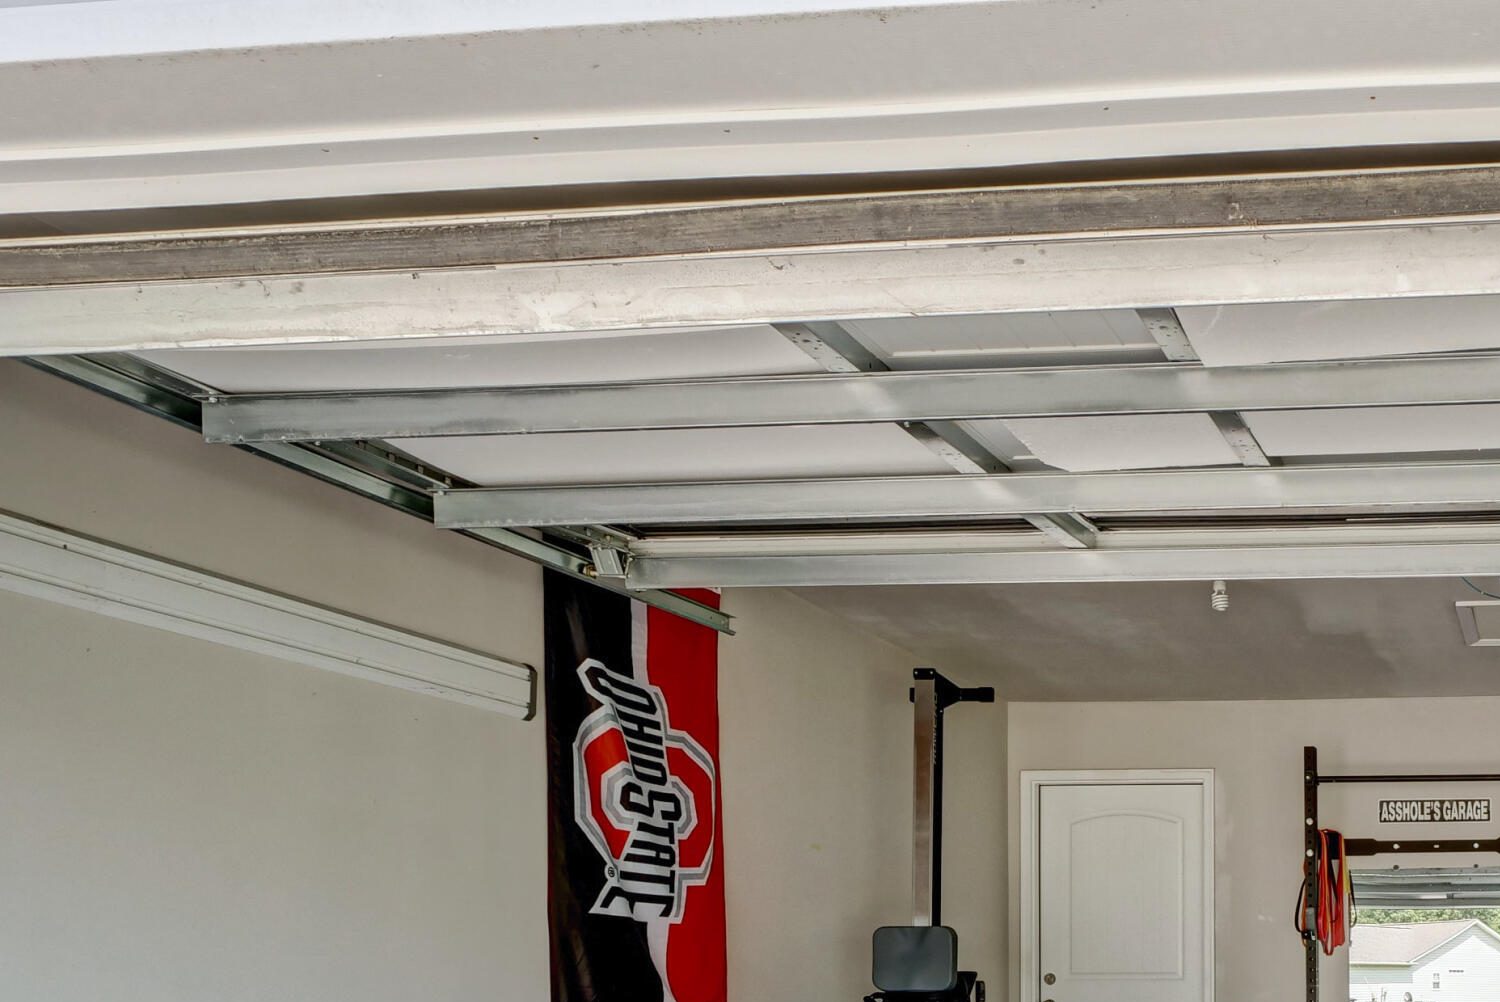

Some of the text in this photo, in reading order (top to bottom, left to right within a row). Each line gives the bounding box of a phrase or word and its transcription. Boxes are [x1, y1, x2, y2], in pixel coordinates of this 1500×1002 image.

[584, 665, 683, 918] OHIO STATE
[1381, 800, 1489, 821] ASSHOLE'S GARAGE
